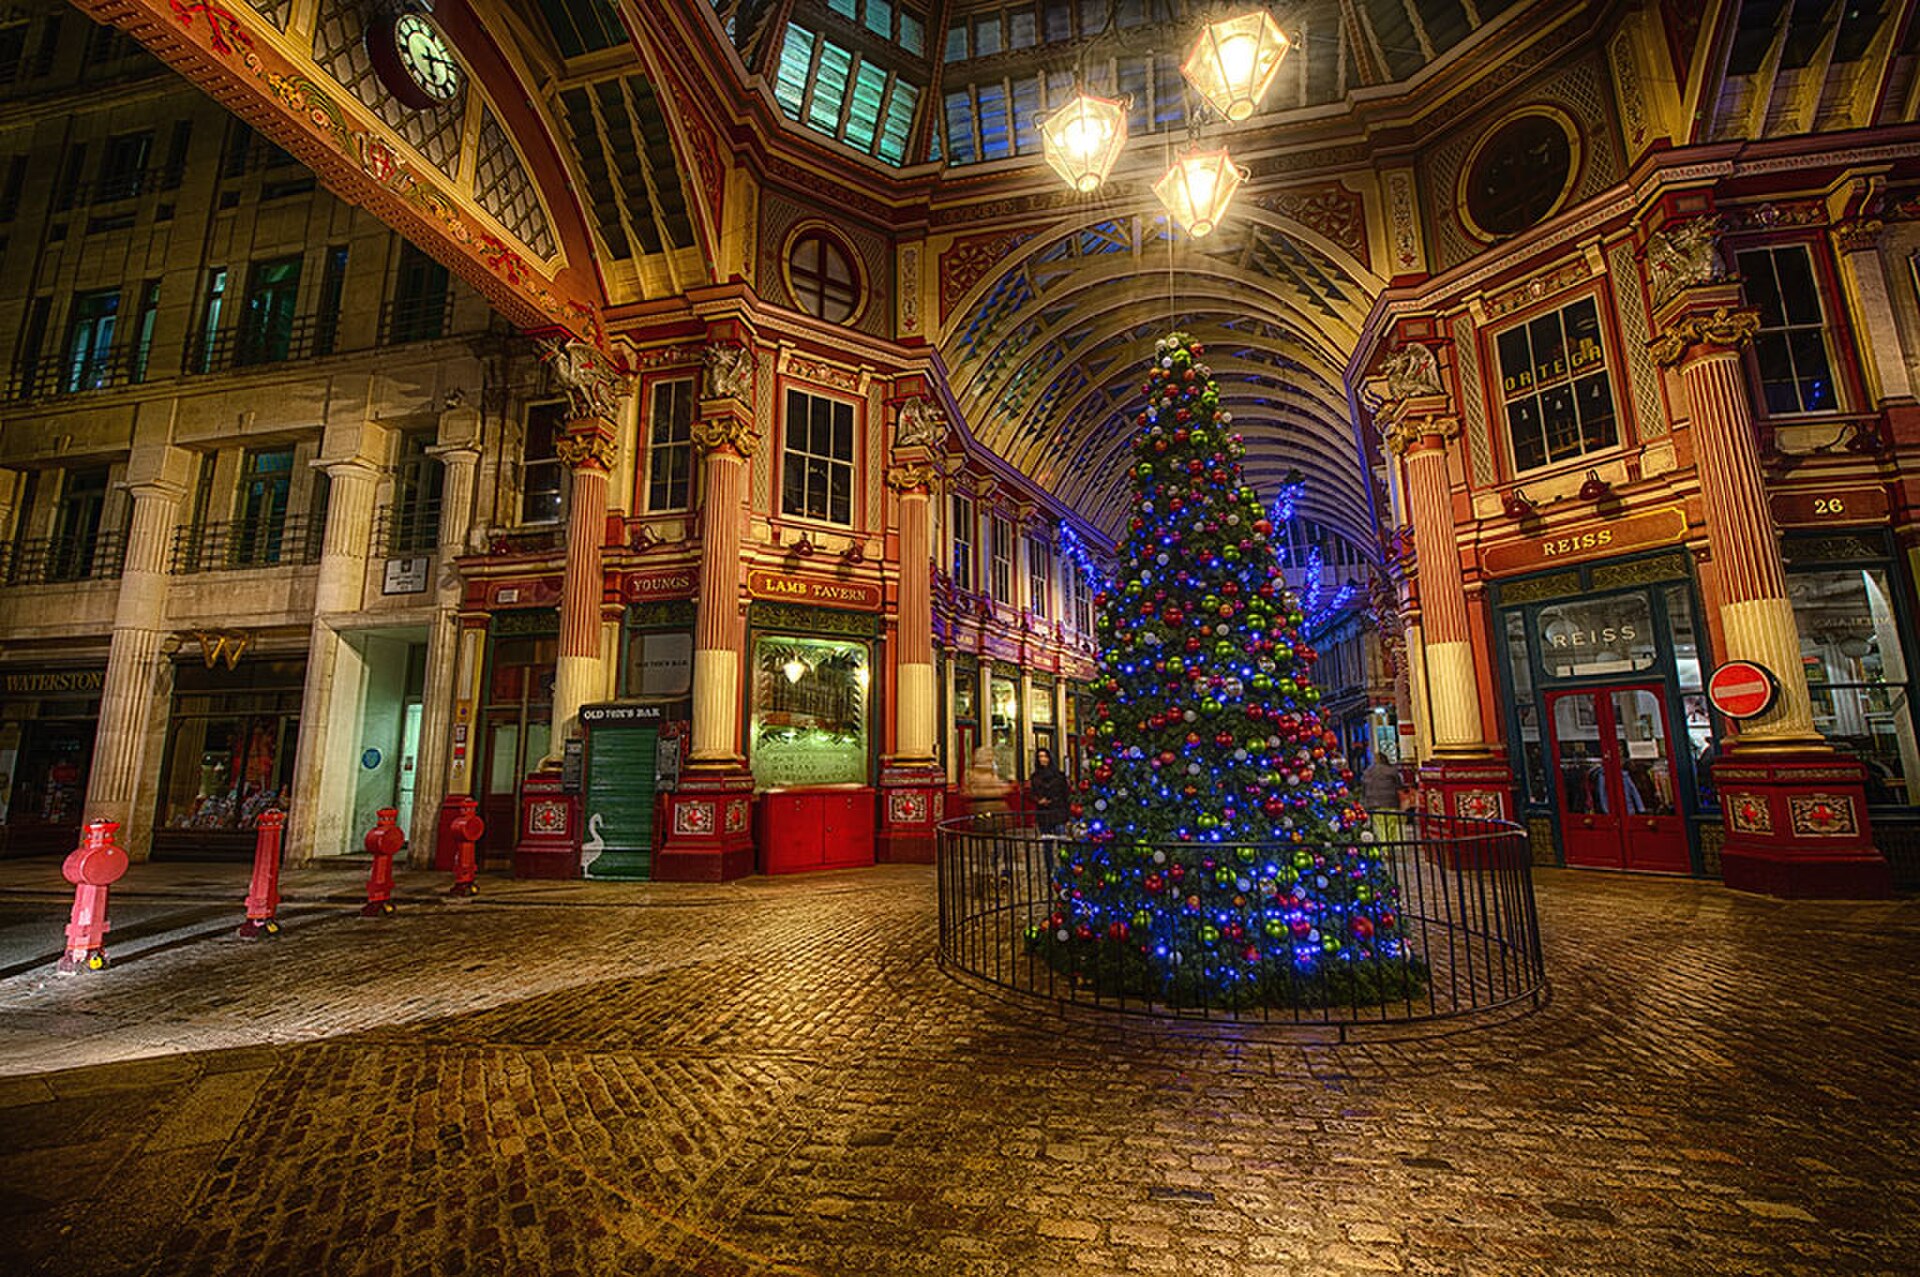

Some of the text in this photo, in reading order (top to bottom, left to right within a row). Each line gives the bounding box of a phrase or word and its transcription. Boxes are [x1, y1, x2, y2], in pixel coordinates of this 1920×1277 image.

[1814, 498, 1843, 514] 26
[1543, 530, 1612, 556] REISS
[633, 576, 690, 592] YOUNGS
[765, 578, 867, 601] LAMB TAVERN
[1552, 625, 1636, 649] REISS
[194, 632, 247, 670] W
[584, 709, 605, 720] OLD
